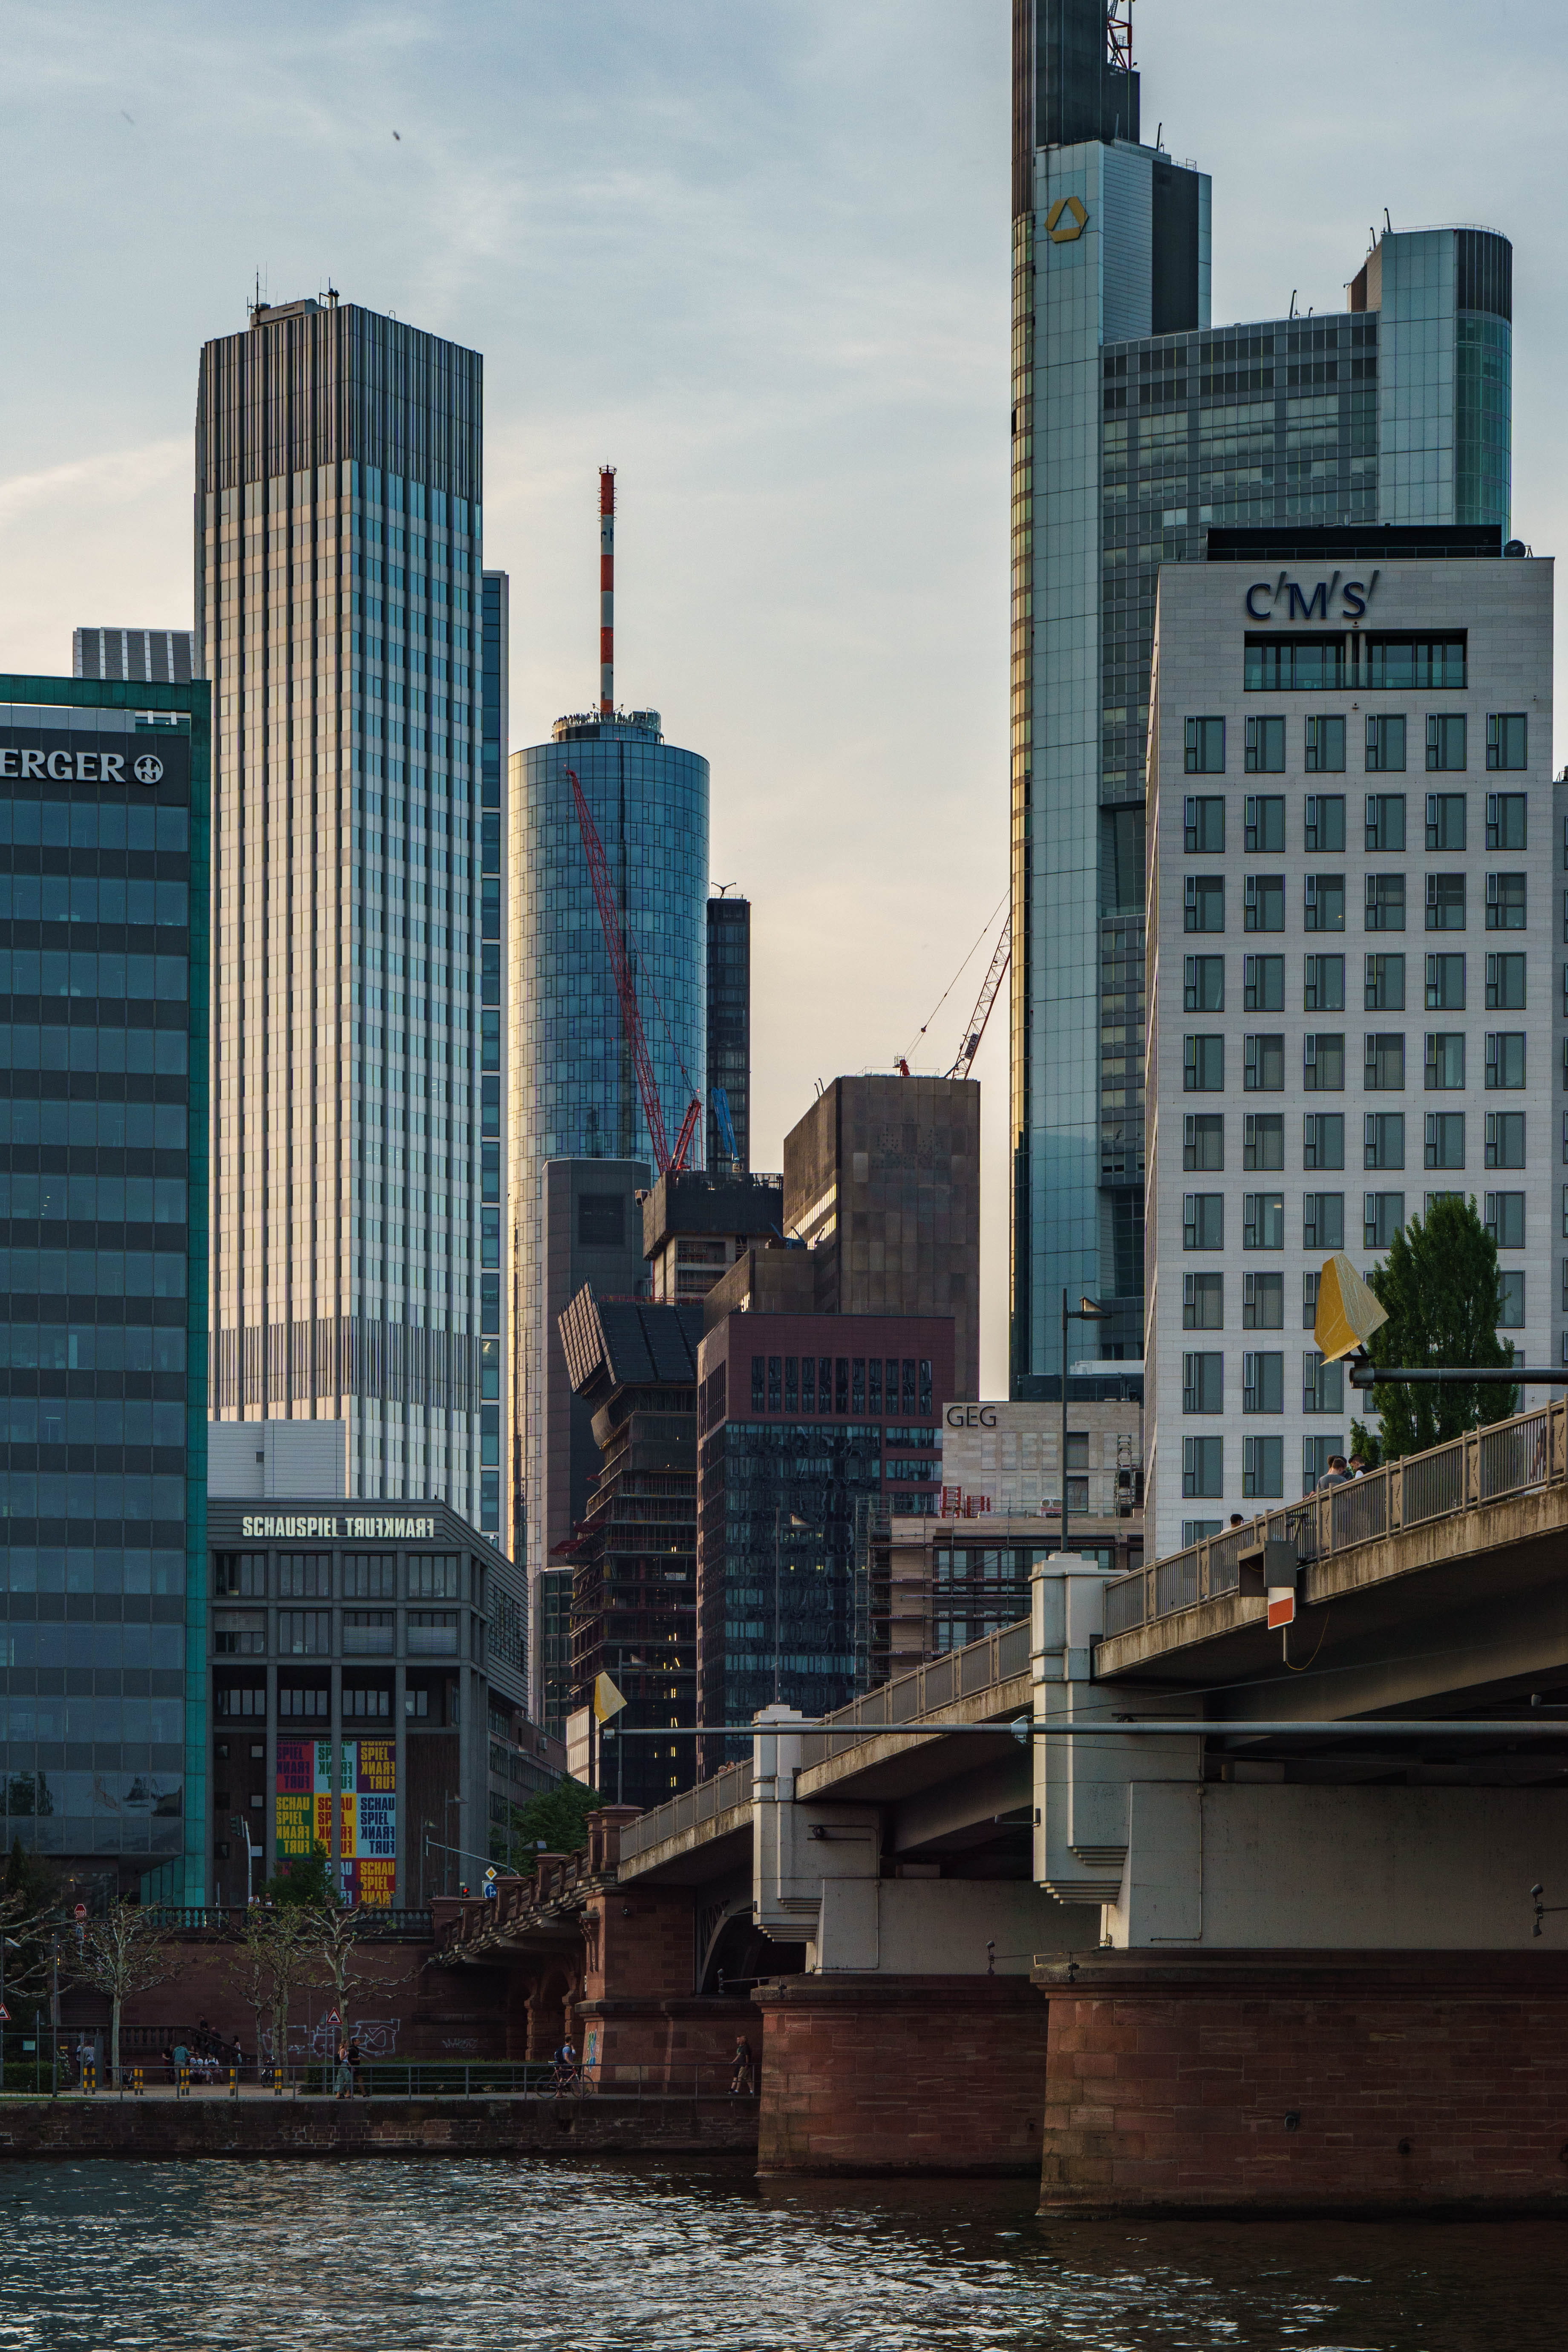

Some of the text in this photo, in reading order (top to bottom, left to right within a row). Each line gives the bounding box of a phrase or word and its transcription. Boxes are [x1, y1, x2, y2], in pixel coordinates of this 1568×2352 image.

[966, 1034, 978, 1058] WOLFF
[946, 1406, 997, 1427] GEG
[242, 1516, 339, 1537] SCHAUSPIEL
[277, 1747, 303, 1760] SPIEL
[318, 1747, 346, 1760] SPL
[361, 1747, 389, 1761] SPIEL
[276, 1796, 310, 1810] SCHAU
[318, 1797, 352, 1810] SCAU
[360, 1797, 395, 1810] SCHAU
[276, 1811, 304, 1825] SPIEL
[318, 1812, 346, 1825] SPL
[360, 1812, 389, 1825] SPIEL
[360, 1862, 395, 1875] SCHAU
[360, 1876, 389, 1890] SPIEL
[75, 1910, 85, 1918] STOP
